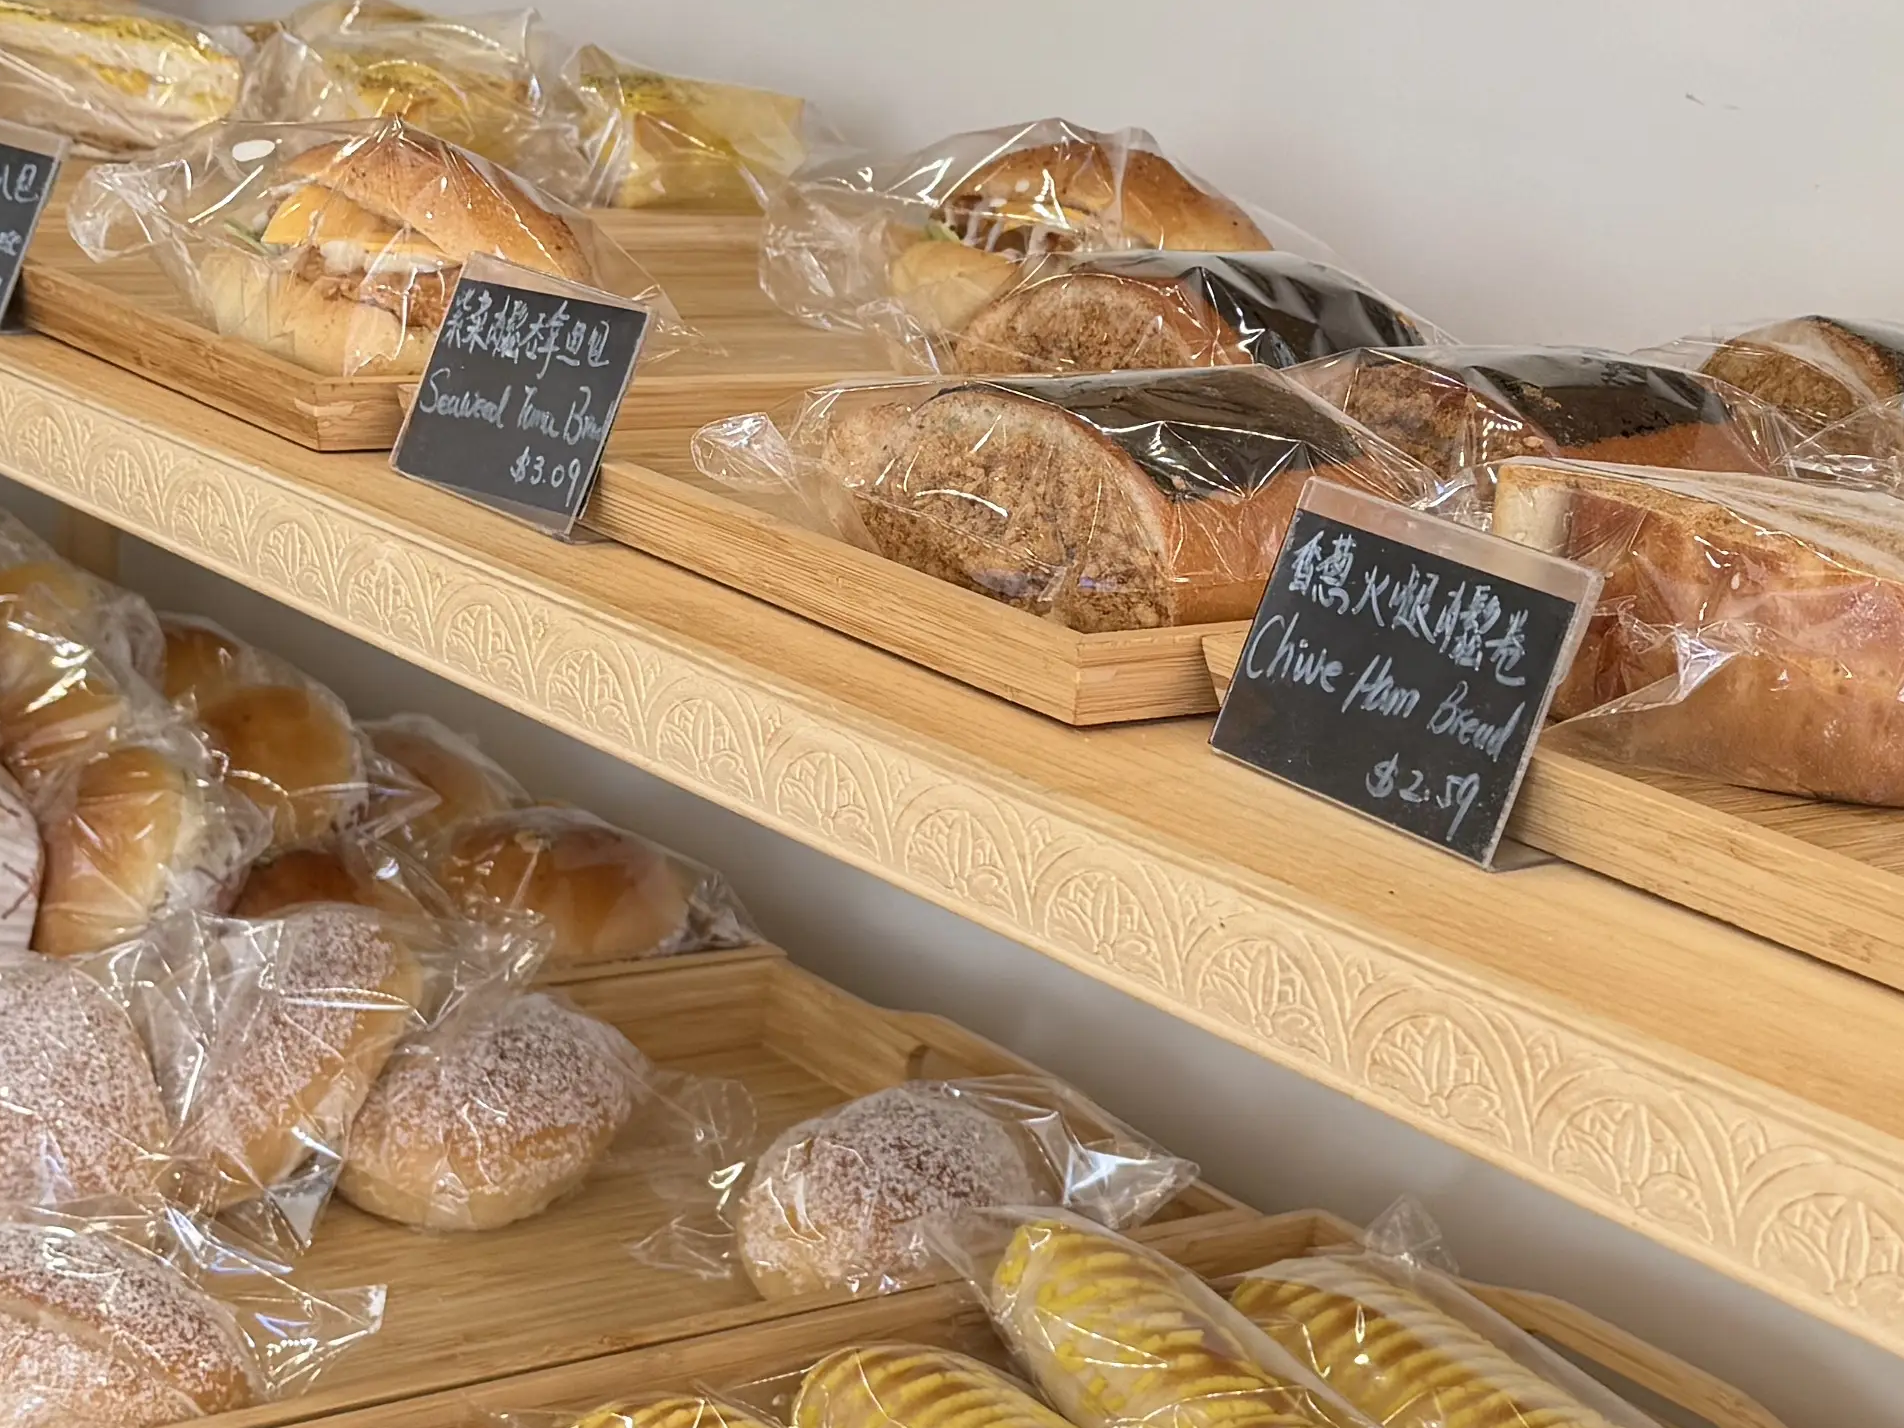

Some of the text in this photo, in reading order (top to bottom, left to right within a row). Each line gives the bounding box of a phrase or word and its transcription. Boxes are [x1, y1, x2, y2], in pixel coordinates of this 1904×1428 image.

[419, 367, 512, 430] Seaweed
[509, 445, 582, 508] $3.09
[1244, 611, 1527, 763] Chive Ham Bread
[1364, 752, 1481, 842] $2.59
